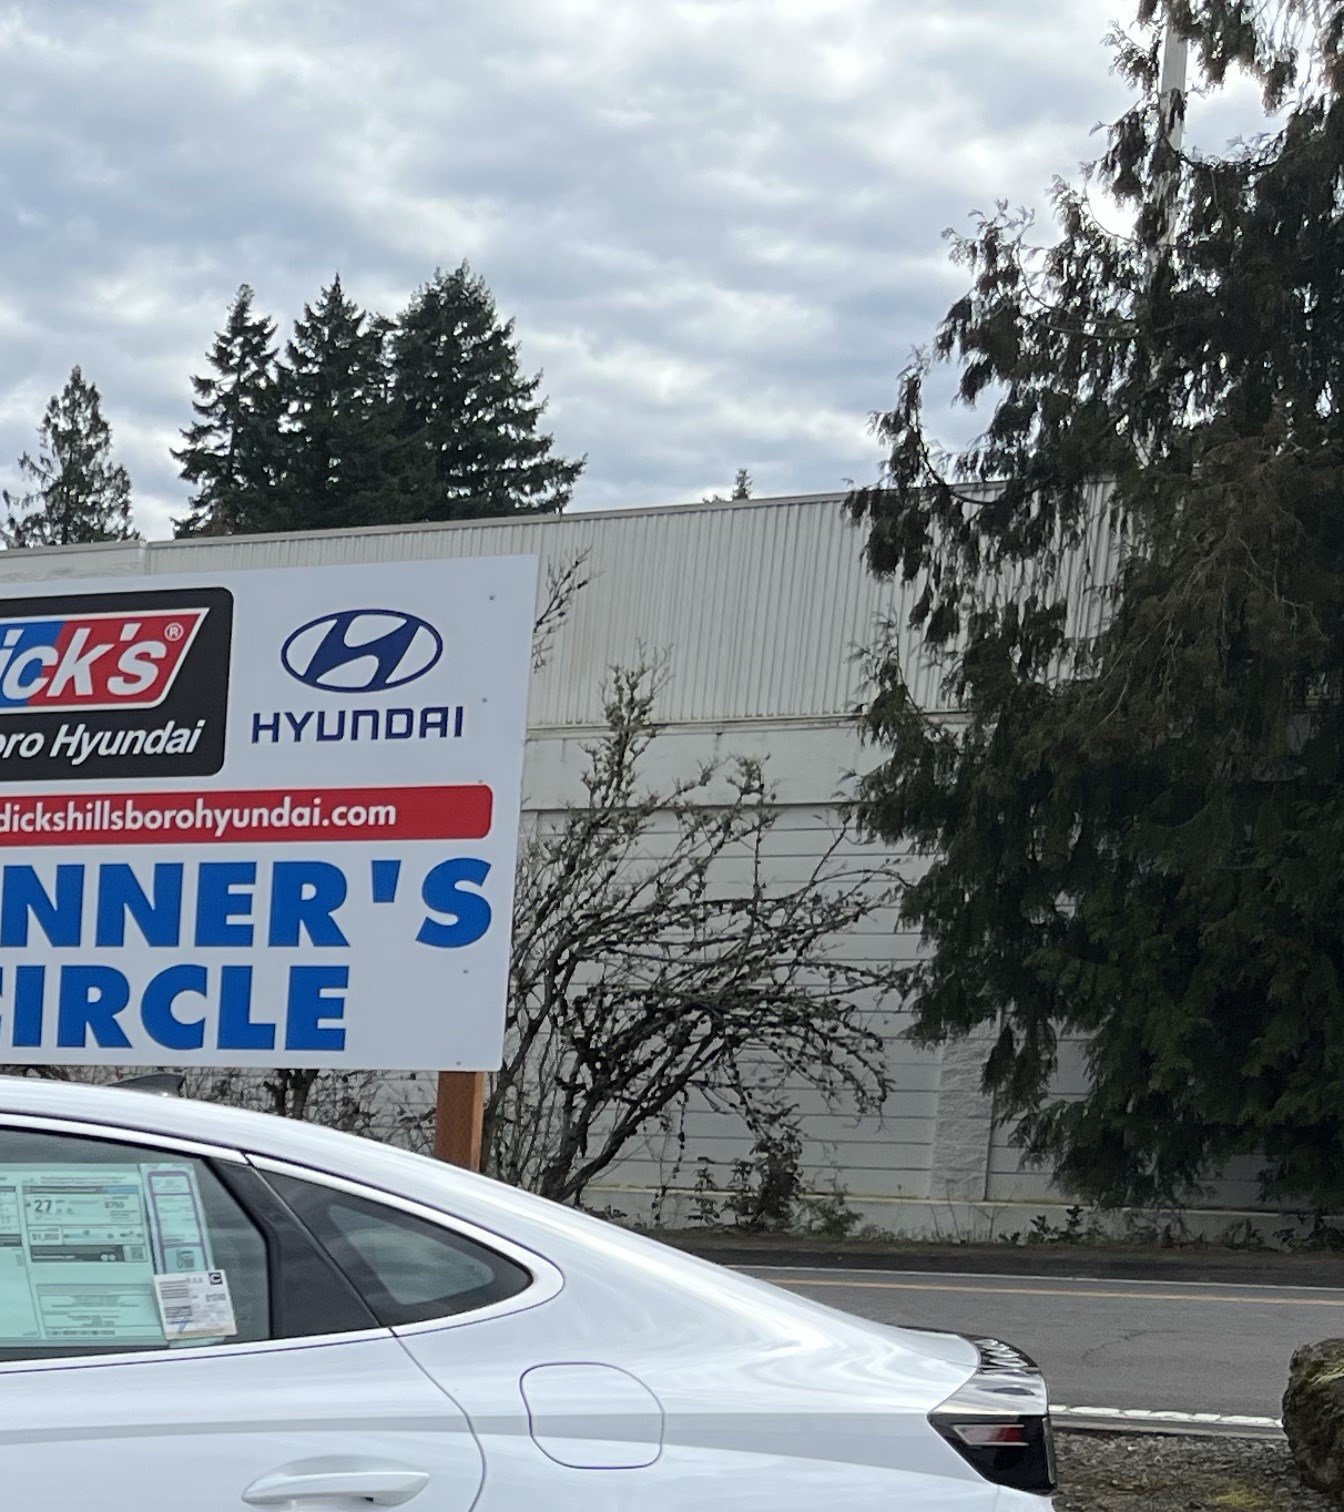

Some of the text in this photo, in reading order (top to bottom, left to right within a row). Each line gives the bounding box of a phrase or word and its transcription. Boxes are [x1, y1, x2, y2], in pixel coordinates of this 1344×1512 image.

[49, 719, 206, 766] Hyundai
[251, 705, 465, 744] HYUNDAI
[33, 1199, 52, 1213] 27
